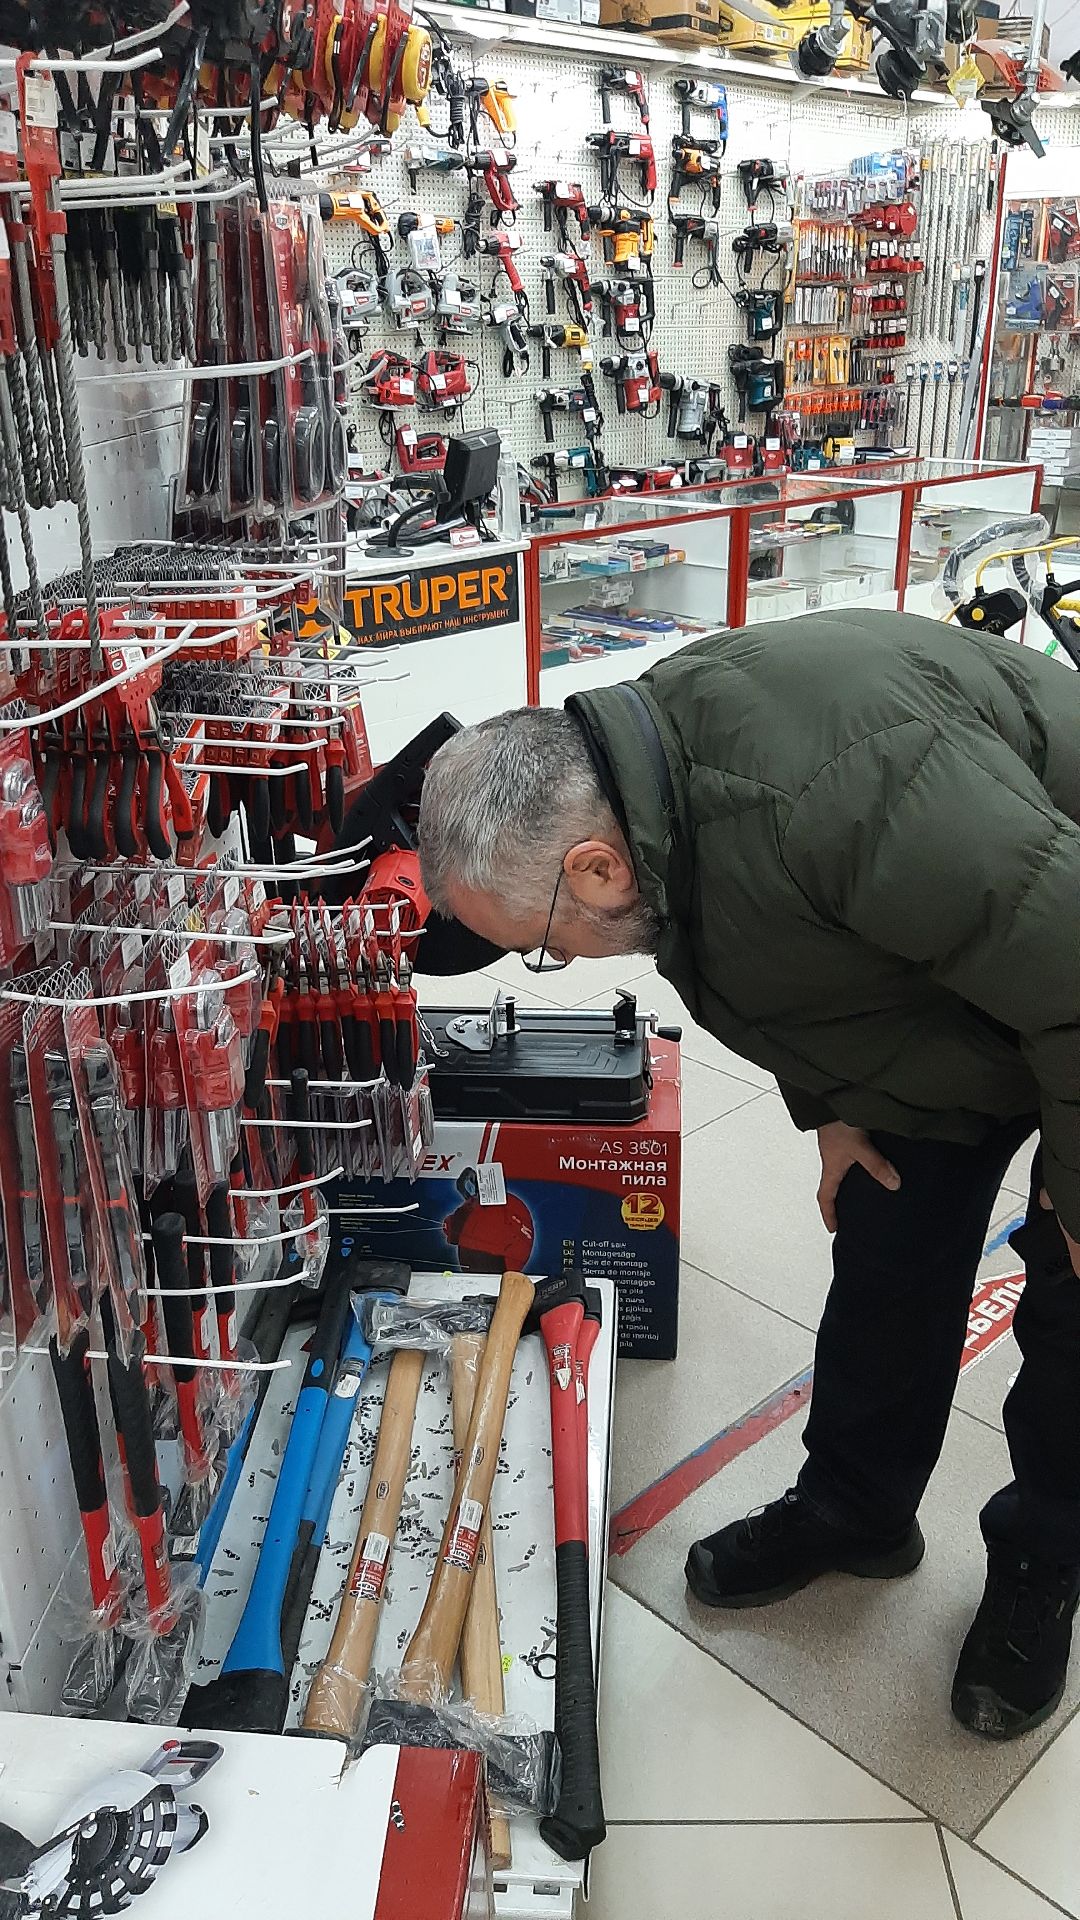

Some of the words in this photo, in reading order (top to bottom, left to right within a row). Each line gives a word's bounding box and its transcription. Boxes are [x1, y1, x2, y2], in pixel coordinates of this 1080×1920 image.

[343, 566, 509, 629] TRUPER
[375, 630, 399, 643] МИРА
[400, 620, 443, 638] ВЫБИРАЮТ
[444, 616, 462, 629] НАШ
[463, 608, 510, 625] ИНСТРУМЕНТ
[599, 1141, 623, 1154] AS
[559, 1156, 667, 1172] Монтажная
[621, 1174, 667, 1186] пила
[624, 1194, 660, 1215] 12
[562, 1239, 575, 1247] EN
[582, 1239, 610, 1248] Cut-off
[613, 1260, 649, 1269] montage
[582, 1267, 606, 1275] Sierra
[619, 1269, 651, 1279] montaje
